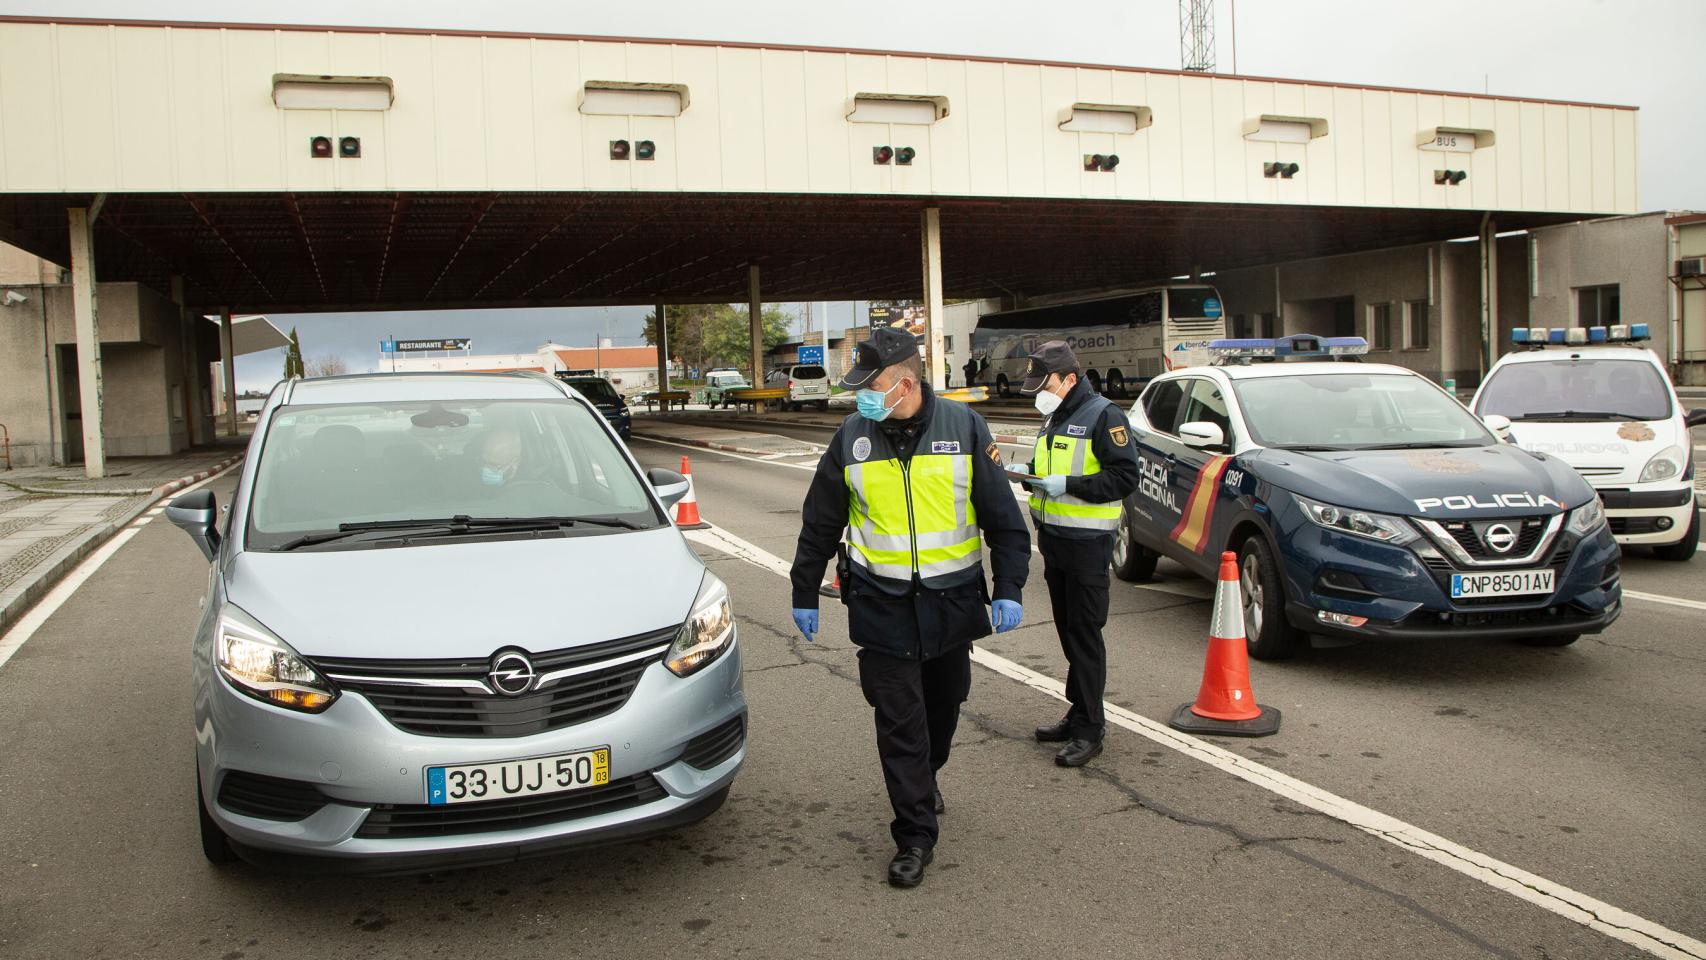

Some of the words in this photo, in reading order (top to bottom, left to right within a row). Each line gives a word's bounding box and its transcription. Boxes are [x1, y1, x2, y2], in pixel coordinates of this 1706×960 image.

[1436, 136, 1457, 147] BUS
[399, 341, 442, 350] RESTAURANTE
[1138, 474, 1182, 516] ACIONAL
[1461, 573, 1552, 593] CNP8501AV
[596, 753, 605, 764] 18
[595, 772, 607, 783] 03
[433, 789, 441, 799] P
